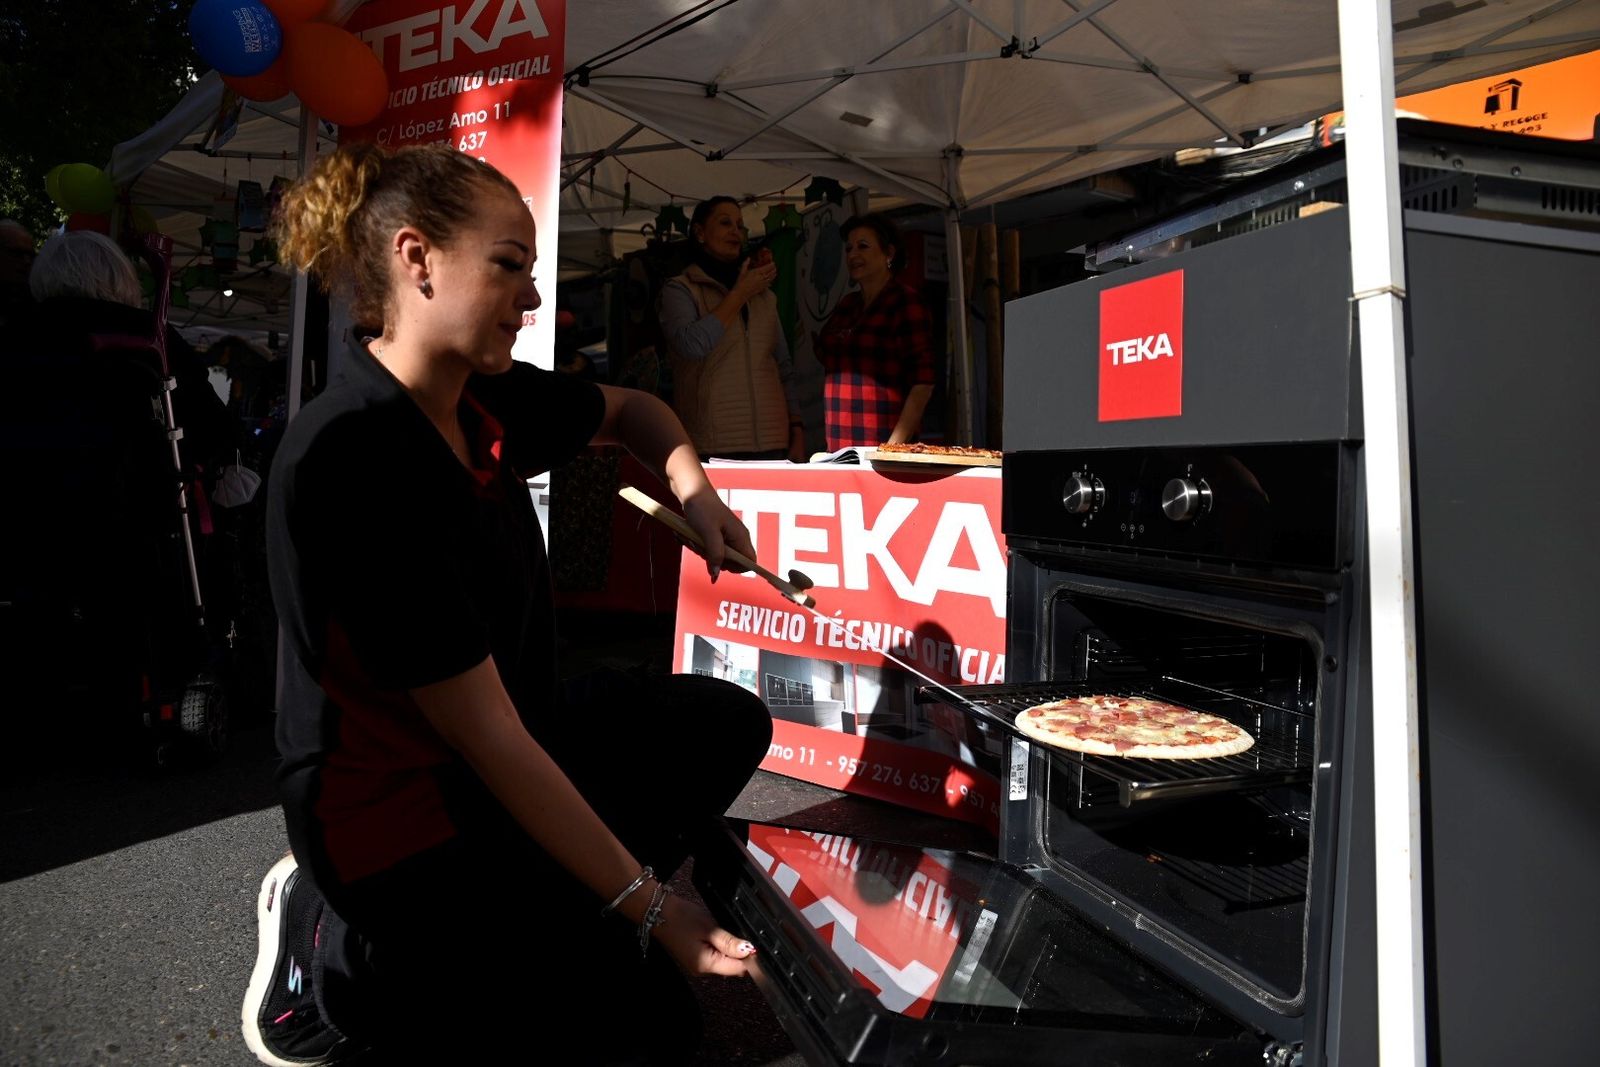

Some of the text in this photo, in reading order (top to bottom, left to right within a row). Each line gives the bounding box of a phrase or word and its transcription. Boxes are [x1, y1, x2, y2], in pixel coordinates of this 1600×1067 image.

[355, 0, 550, 73] TEKA
[387, 55, 552, 110] ICIO TÉCNICO OFICIAL
[399, 117, 445, 141] López
[449, 109, 488, 130] Amo
[494, 101, 512, 120] 11
[458, 130, 488, 152] 637
[522, 313, 537, 327] OS
[1106, 332, 1174, 366] TEKA
[716, 488, 1007, 618] TEKA
[716, 600, 1006, 685] SERVICIO TÉCNICO OFICIA
[766, 743, 794, 761] mo
[799, 746, 816, 766] 11
[838, 755, 868, 778] 957
[872, 763, 904, 786] 276
[908, 774, 941, 797] 637
